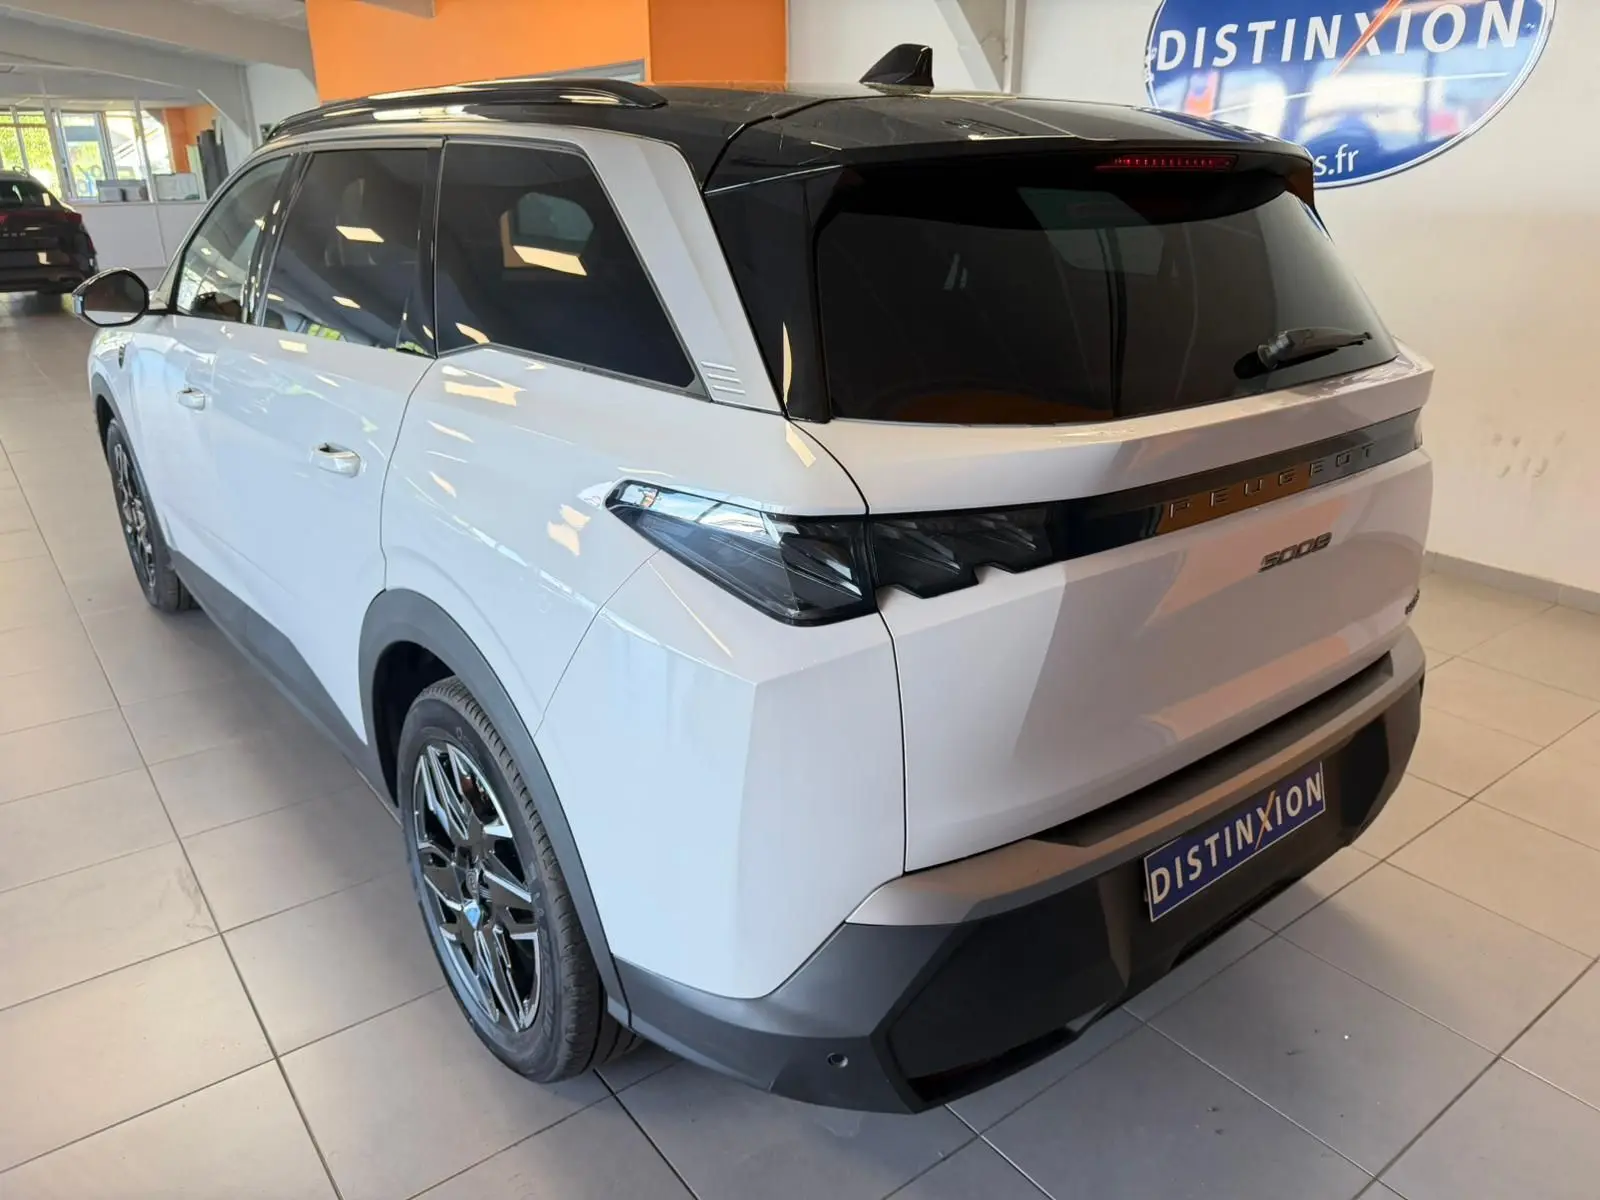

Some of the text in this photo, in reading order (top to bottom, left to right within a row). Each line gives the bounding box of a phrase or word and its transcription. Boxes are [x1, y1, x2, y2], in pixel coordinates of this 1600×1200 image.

[1156, 0, 1524, 71] DISTINXION
[1169, 442, 1375, 518] PEUGEOT
[1257, 531, 1332, 573] 5008
[1150, 771, 1322, 904] DISTINXION
